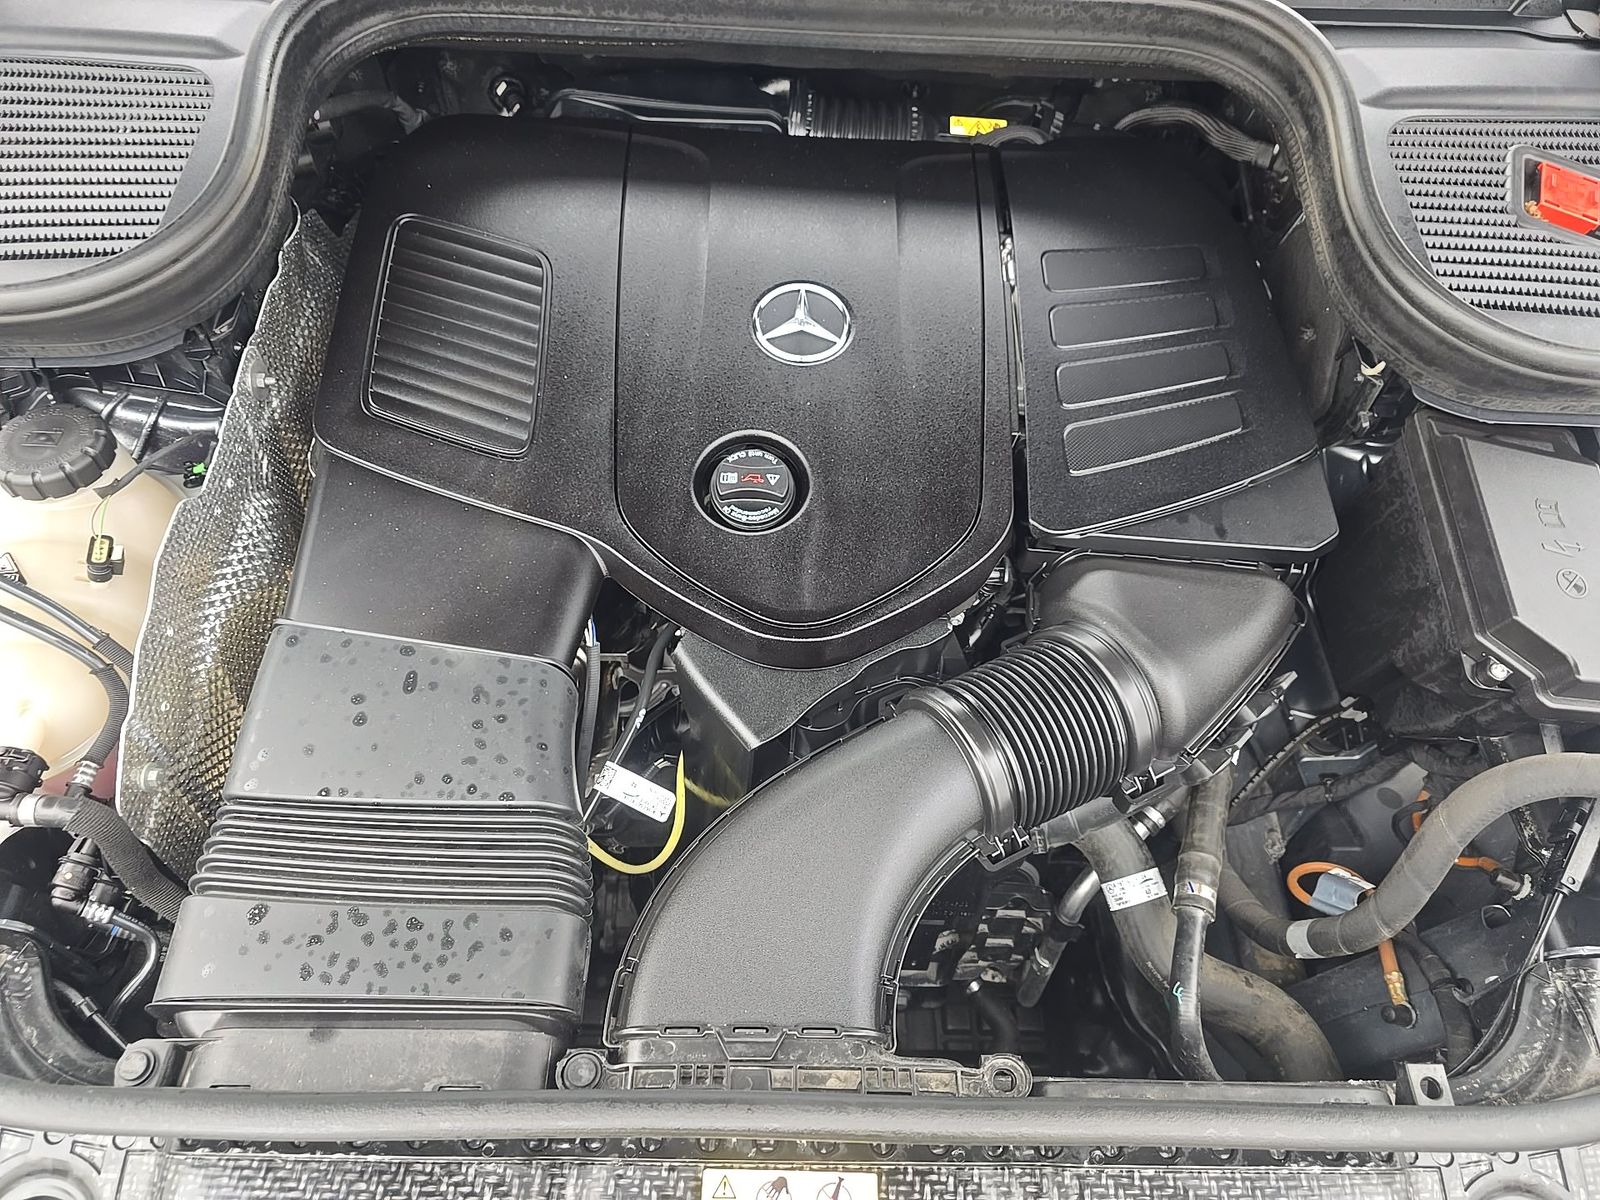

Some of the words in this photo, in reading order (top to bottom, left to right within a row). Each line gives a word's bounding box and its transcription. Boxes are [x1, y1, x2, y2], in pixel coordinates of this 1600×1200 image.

[726, 451, 747, 463] CLICK
[748, 450, 763, 458] until
[764, 453, 778, 465] Turn
[731, 507, 780, 522] Mercedes-Benz
